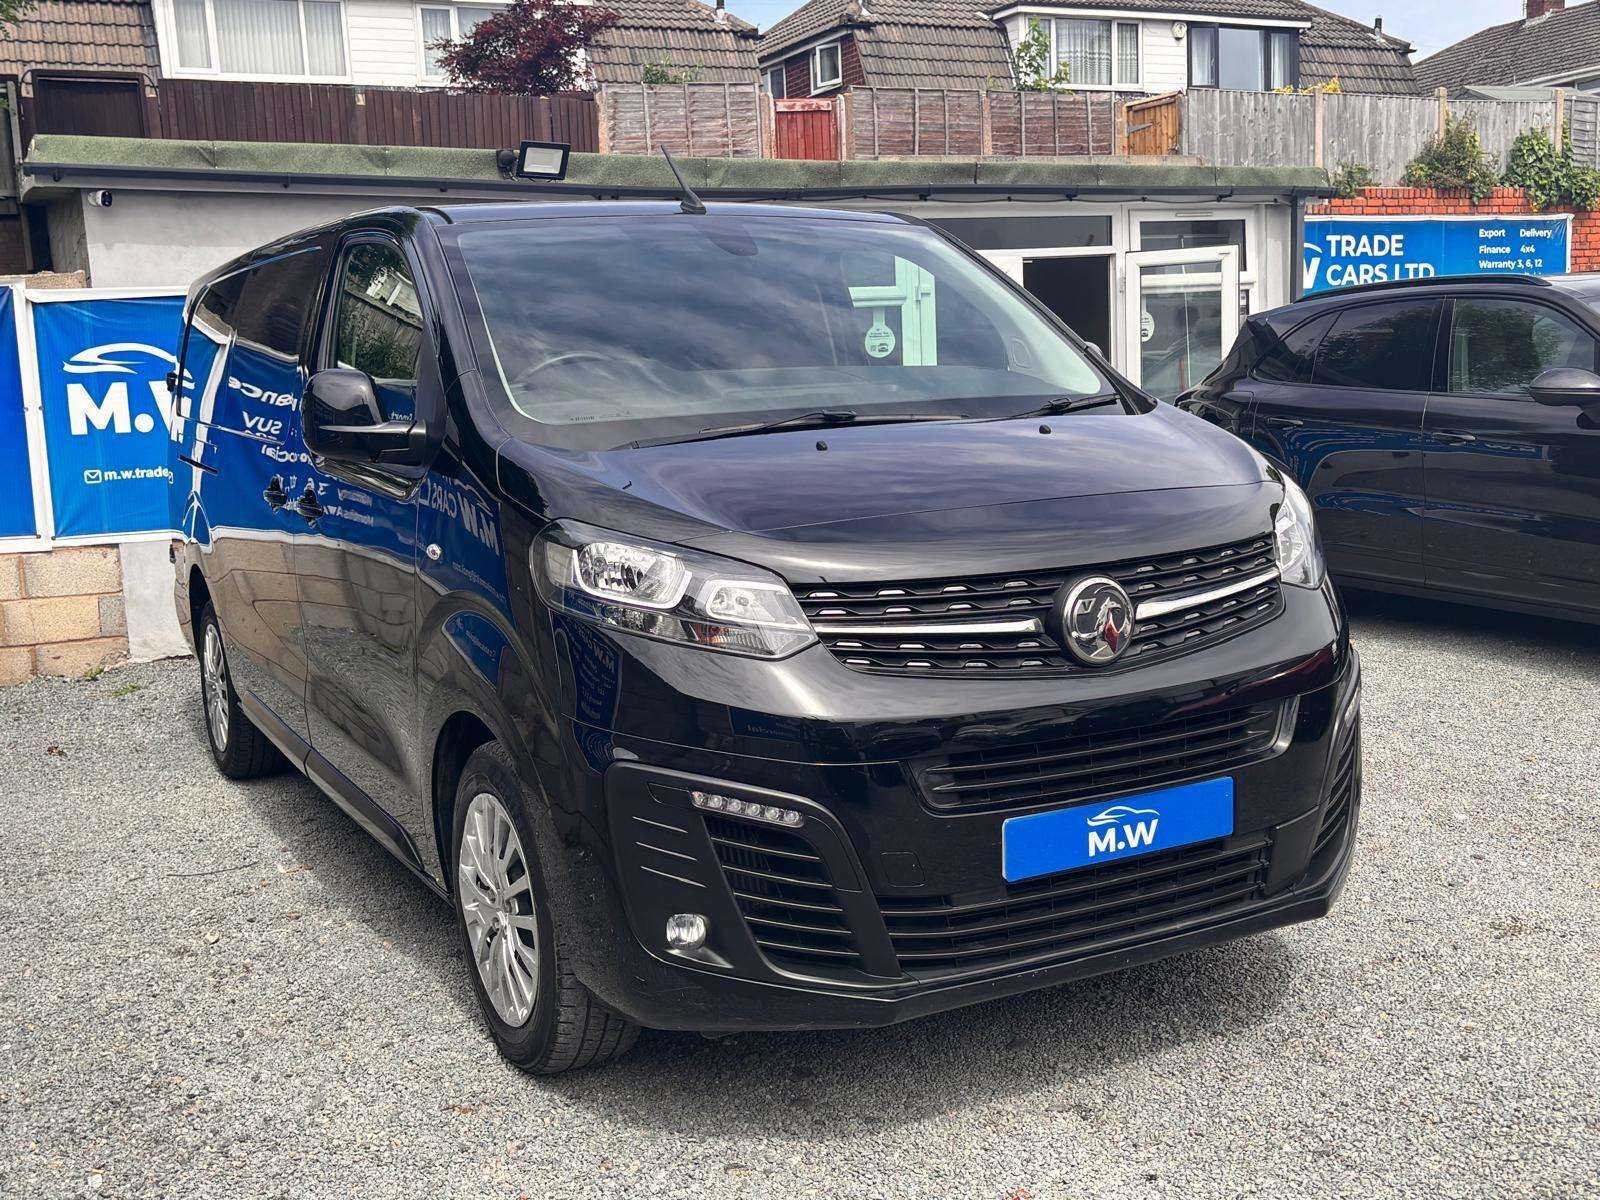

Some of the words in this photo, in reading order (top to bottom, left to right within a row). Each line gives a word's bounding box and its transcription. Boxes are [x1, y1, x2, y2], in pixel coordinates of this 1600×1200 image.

[1479, 228, 1506, 239] Export
[1519, 228, 1553, 239] Delivery
[1325, 234, 1405, 257] TRADE
[1479, 244, 1512, 254] Finance
[1519, 244, 1536, 254] 4x4
[1478, 259, 1517, 270] Warranty
[1534, 258, 1543, 268] 12
[1325, 263, 1389, 287] CARS
[1088, 818, 1159, 857] M.W
